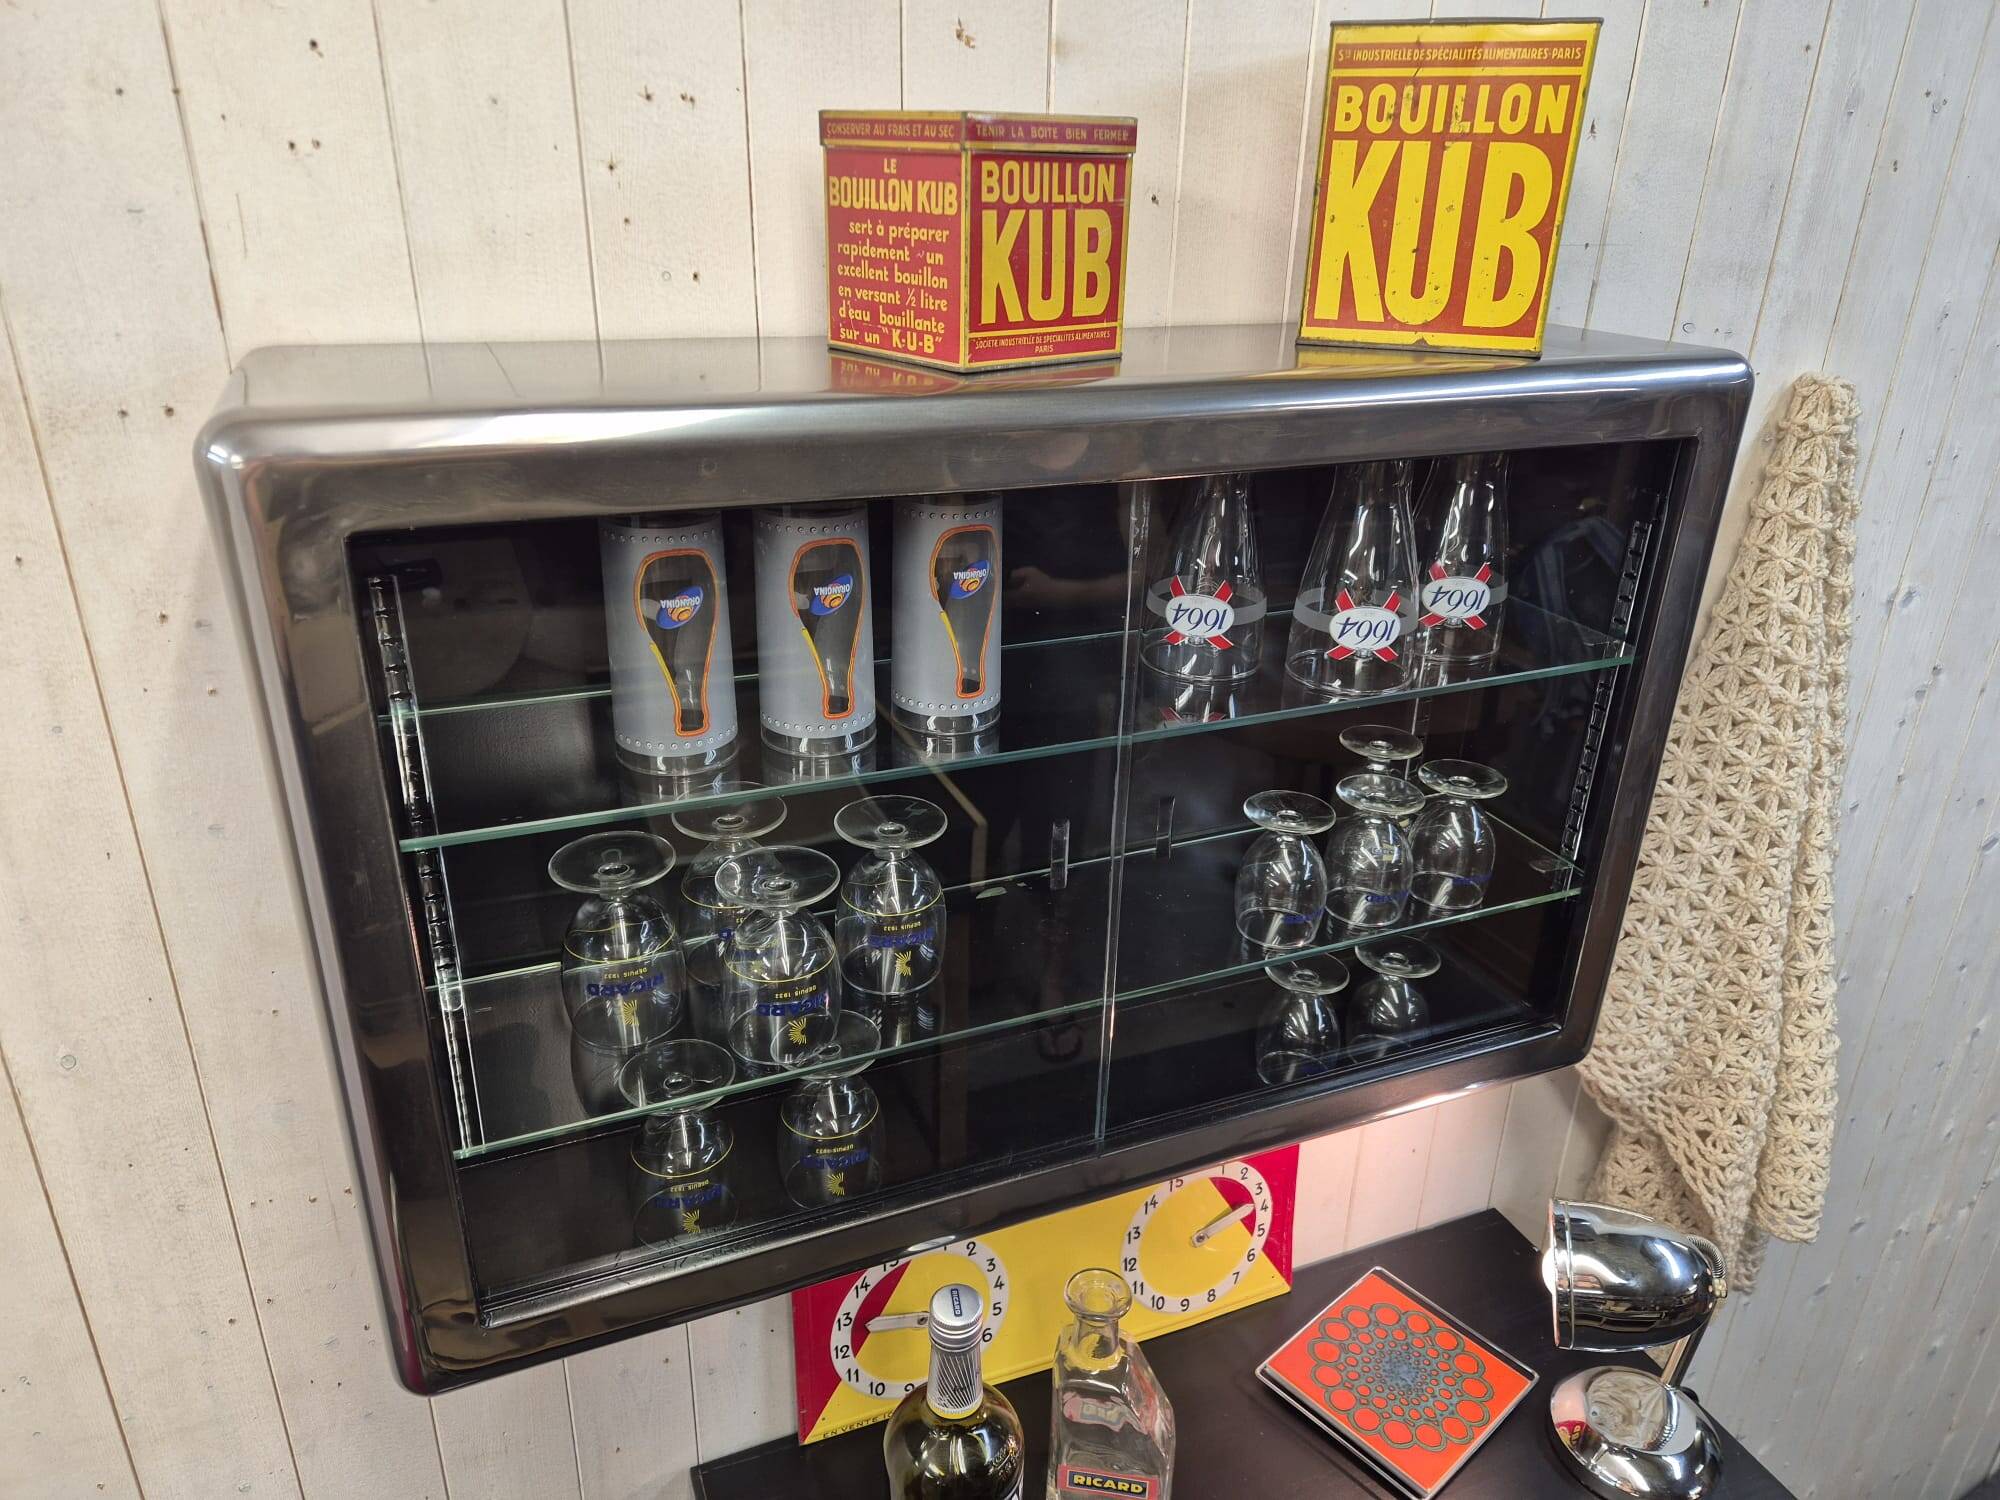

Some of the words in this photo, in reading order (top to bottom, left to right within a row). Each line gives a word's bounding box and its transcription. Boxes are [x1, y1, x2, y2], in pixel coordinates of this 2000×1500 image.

[1353, 48, 1412, 61] INDUSTRIELLE
[1413, 47, 1424, 61] DE
[1426, 46, 1482, 61] SPÉCIALITÉS
[1483, 47, 1549, 61] ALIMENTAIRES
[1552, 47, 1582, 60] PARIS
[1334, 83, 1570, 135] BOUILLON
[827, 122, 870, 137] CONSERVER
[873, 123, 885, 136] AU
[888, 124, 910, 137] FRAIS
[912, 124, 922, 137] ET
[924, 124, 937, 137] AU
[938, 125, 955, 137] SEC
[976, 124, 1005, 137] TENIR
[1011, 126, 1024, 138] LA
[1066, 127, 1087, 140] BIEN
[884, 158, 897, 174] LE
[982, 160, 1116, 204] BOUILLON
[828, 176, 912, 213] BOUILLON
[917, 180, 958, 215] KUB
[849, 219, 873, 235] sert
[876, 220, 884, 235] à
[889, 222, 949, 247] préparer
[1314, 140, 1553, 328] KUB
[837, 238, 910, 263] rapidement
[926, 252, 944, 265] un
[981, 209, 1112, 324] KUB
[837, 260, 889, 282] excellent
[894, 263, 948, 289] bouillon
[838, 285, 851, 298] en
[855, 288, 901, 305] versant
[920, 289, 948, 312] litre
[839, 300, 870, 321] d'eau
[879, 305, 945, 333] bouillante
[840, 326, 859, 340] sur
[865, 332, 880, 344] un
[1035, 345, 1054, 353] PARIS
[953, 569, 987, 580] ORANGINA
[814, 583, 850, 596] ORANGINA
[660, 596, 700, 609] ORANGINA
[1428, 586, 1486, 613] 1664
[1170, 603, 1228, 633] 1664
[1336, 616, 1396, 646] 1664
[623, 967, 648, 978] DEPUIS
[794, 984, 817, 996] DEPUIS
[1240, 1167, 1249, 1180] 2
[1255, 1182, 1263, 1195] 3
[1144, 1195, 1158, 1215] 14
[1260, 1200, 1269, 1212] 4
[1127, 1226, 1141, 1244] 13
[1257, 1223, 1265, 1237] 5
[966, 1241, 977, 1256] 2
[1247, 1248, 1255, 1262] 6
[986, 1258, 996, 1273] 3
[1123, 1257, 1137, 1271] 12
[994, 1275, 1004, 1290] 4
[1232, 1272, 1240, 1284] 7
[854, 1276, 871, 1299] 14
[1133, 1281, 1144, 1295] 11
[952, 1289, 961, 1315] RICARD
[1152, 1295, 1165, 1310] 10
[1207, 1289, 1216, 1302] 8
[992, 1302, 1002, 1316] 5
[1180, 1299, 1190, 1311] 9
[836, 1312, 853, 1331] 13
[982, 1328, 993, 1342] 6
[834, 1345, 850, 1359] 12
[846, 1368, 859, 1383] 11
[869, 1382, 885, 1396] 10
[823, 1429, 838, 1438] EN
[841, 1417, 878, 1431] VENTE
[1073, 1474, 1143, 1493] RICARD
